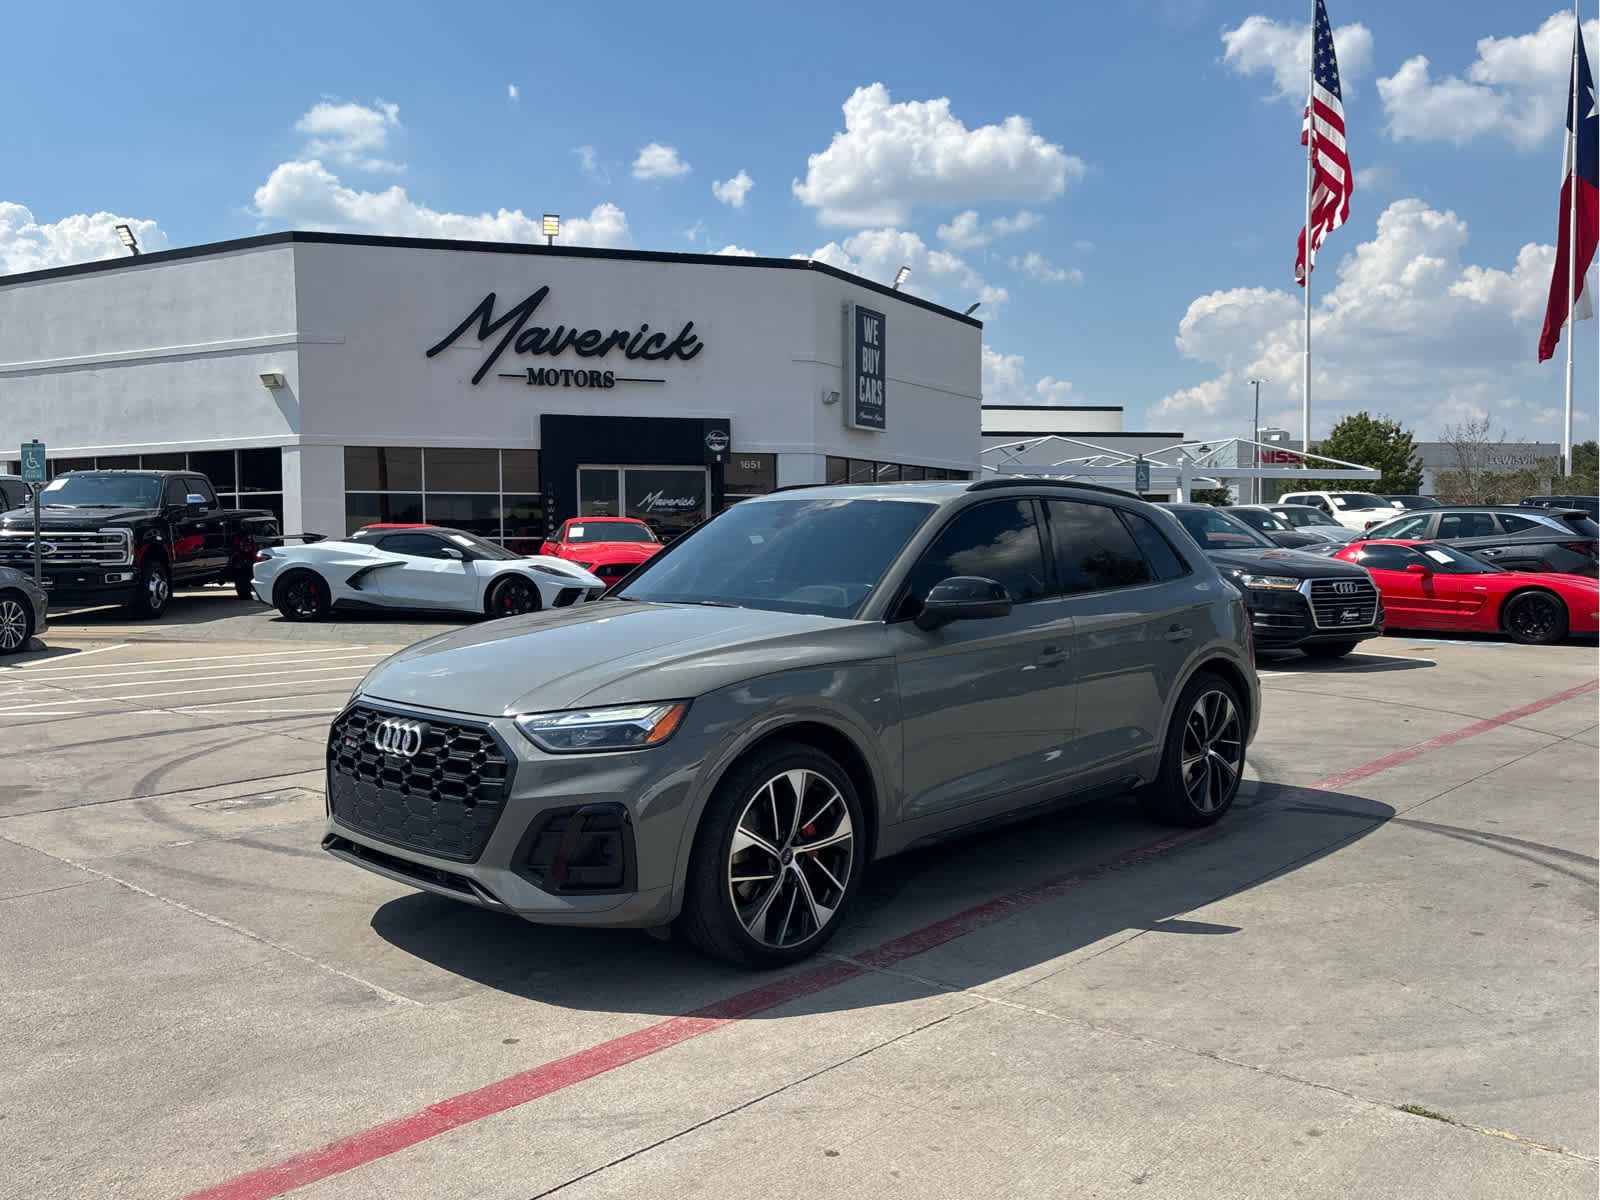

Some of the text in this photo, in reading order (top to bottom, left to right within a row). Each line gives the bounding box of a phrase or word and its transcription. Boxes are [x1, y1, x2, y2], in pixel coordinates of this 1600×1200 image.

[426, 285, 704, 385] Maverick
[863, 316, 879, 346] WE
[862, 346, 881, 375] BUY
[526, 367, 616, 389] MOTORS
[859, 375, 883, 406] CARS
[740, 460, 761, 469] 1651
[1258, 450, 1304, 465] NISS
[1487, 452, 1537, 465] Lewisvill
[637, 489, 696, 513] Maverick
